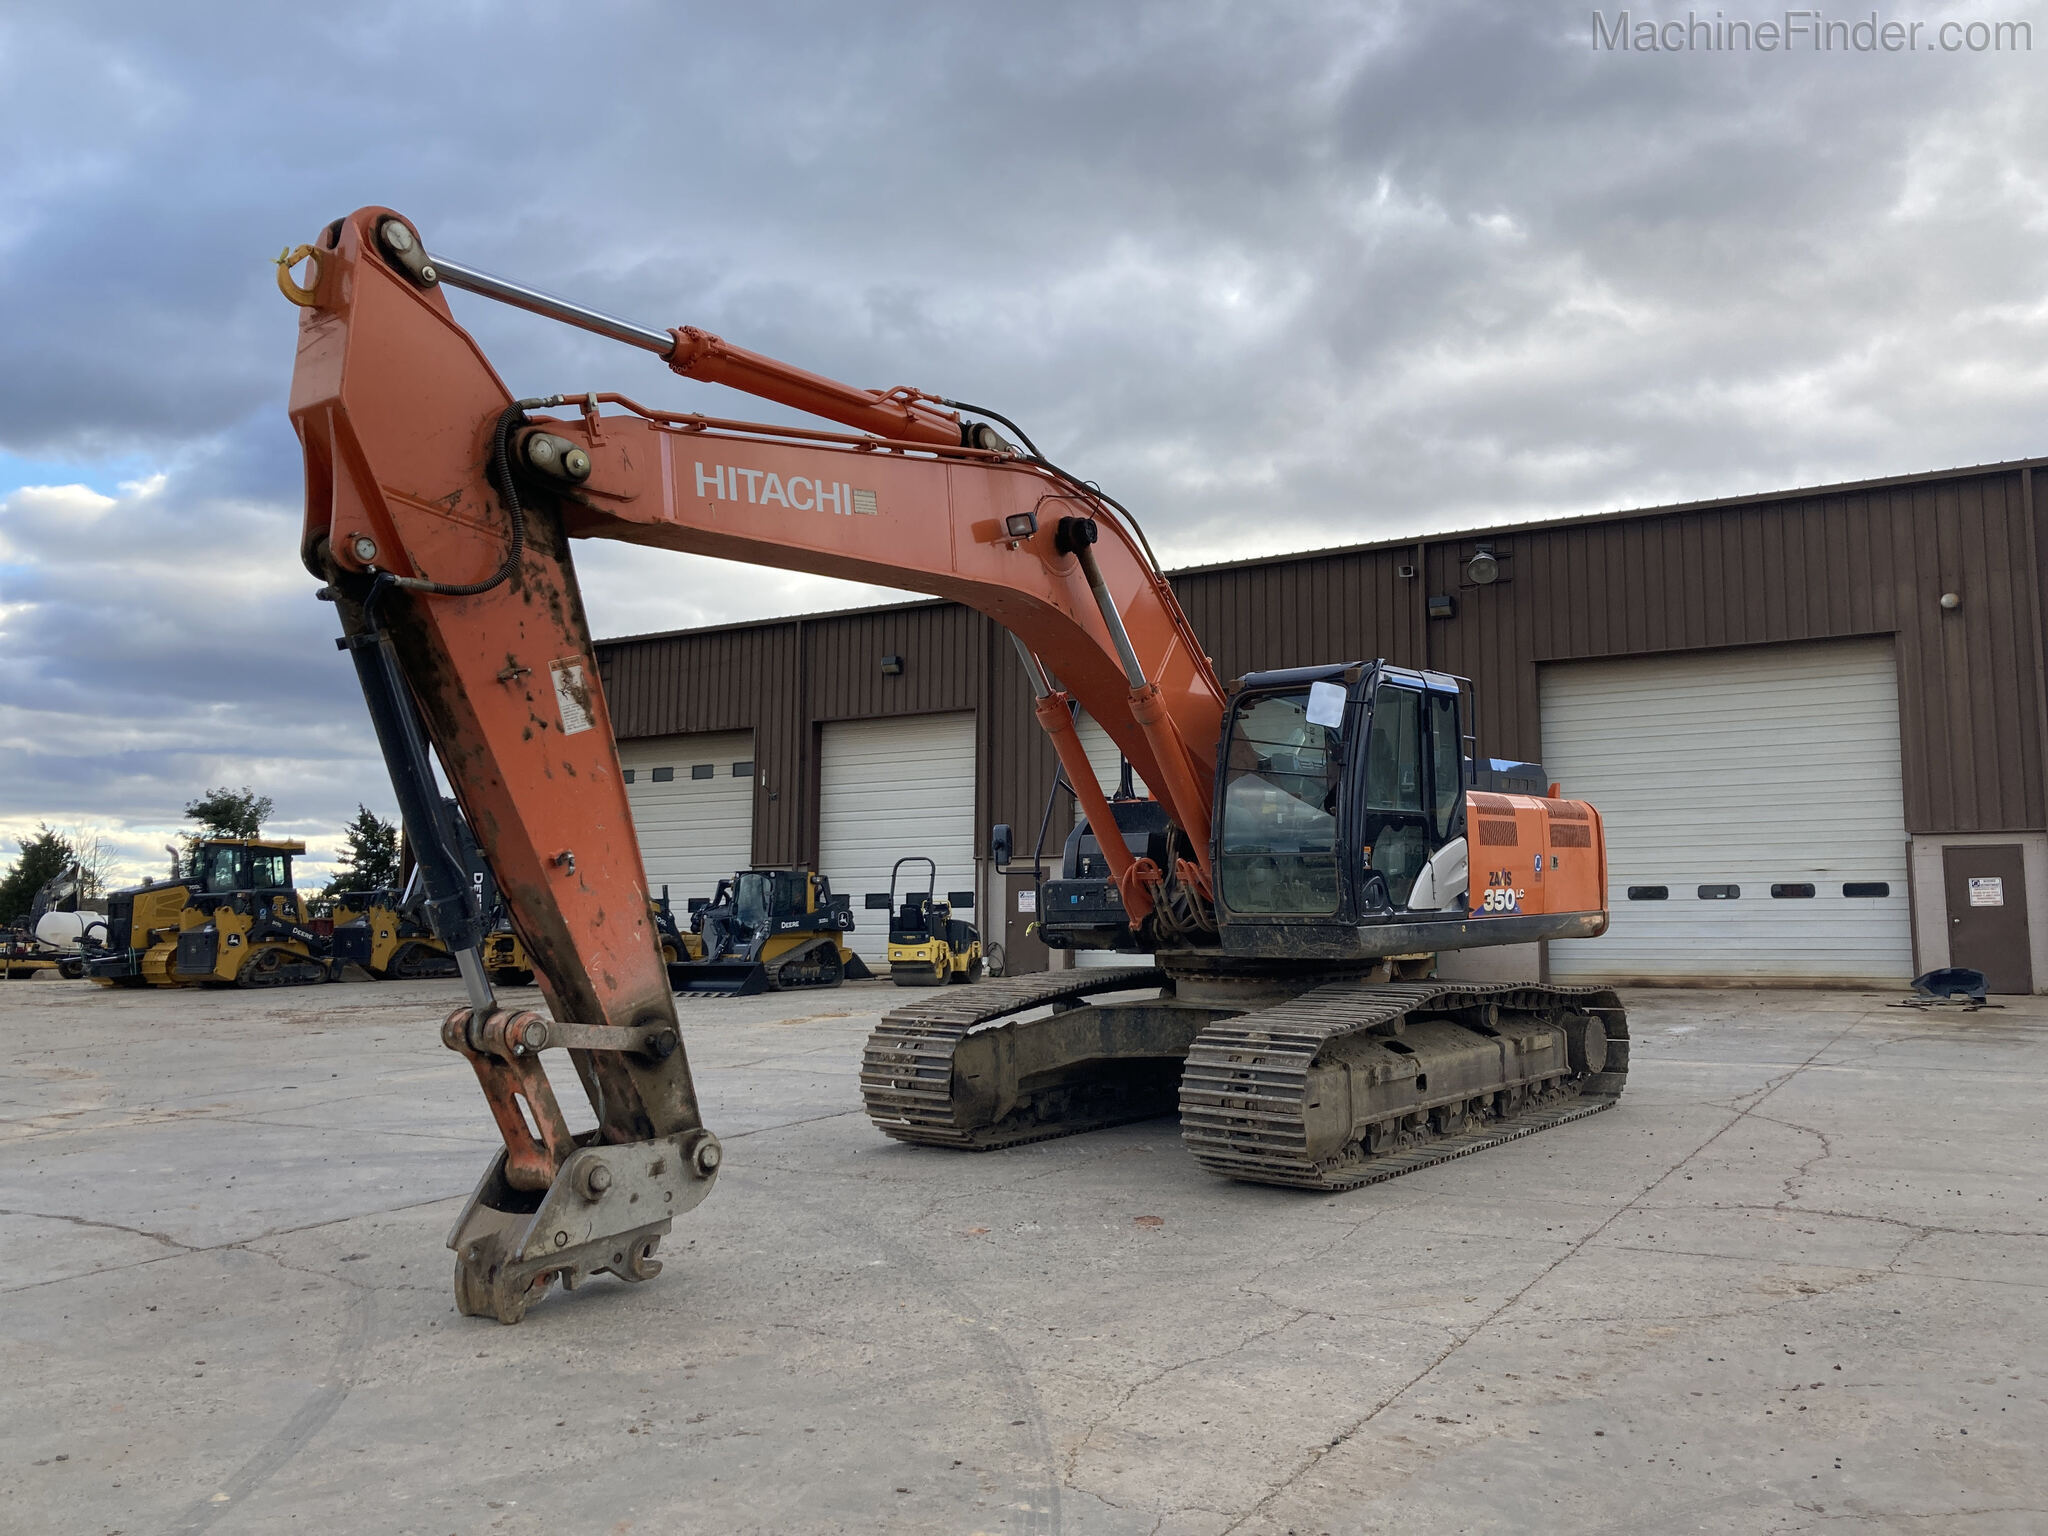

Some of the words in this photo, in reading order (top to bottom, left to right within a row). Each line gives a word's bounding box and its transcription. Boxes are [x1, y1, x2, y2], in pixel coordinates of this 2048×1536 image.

[694, 461, 852, 516] HITACHI
[1483, 888, 1516, 912] 350
[292, 927, 314, 939] DEERE
[781, 921, 800, 929] DEERE
